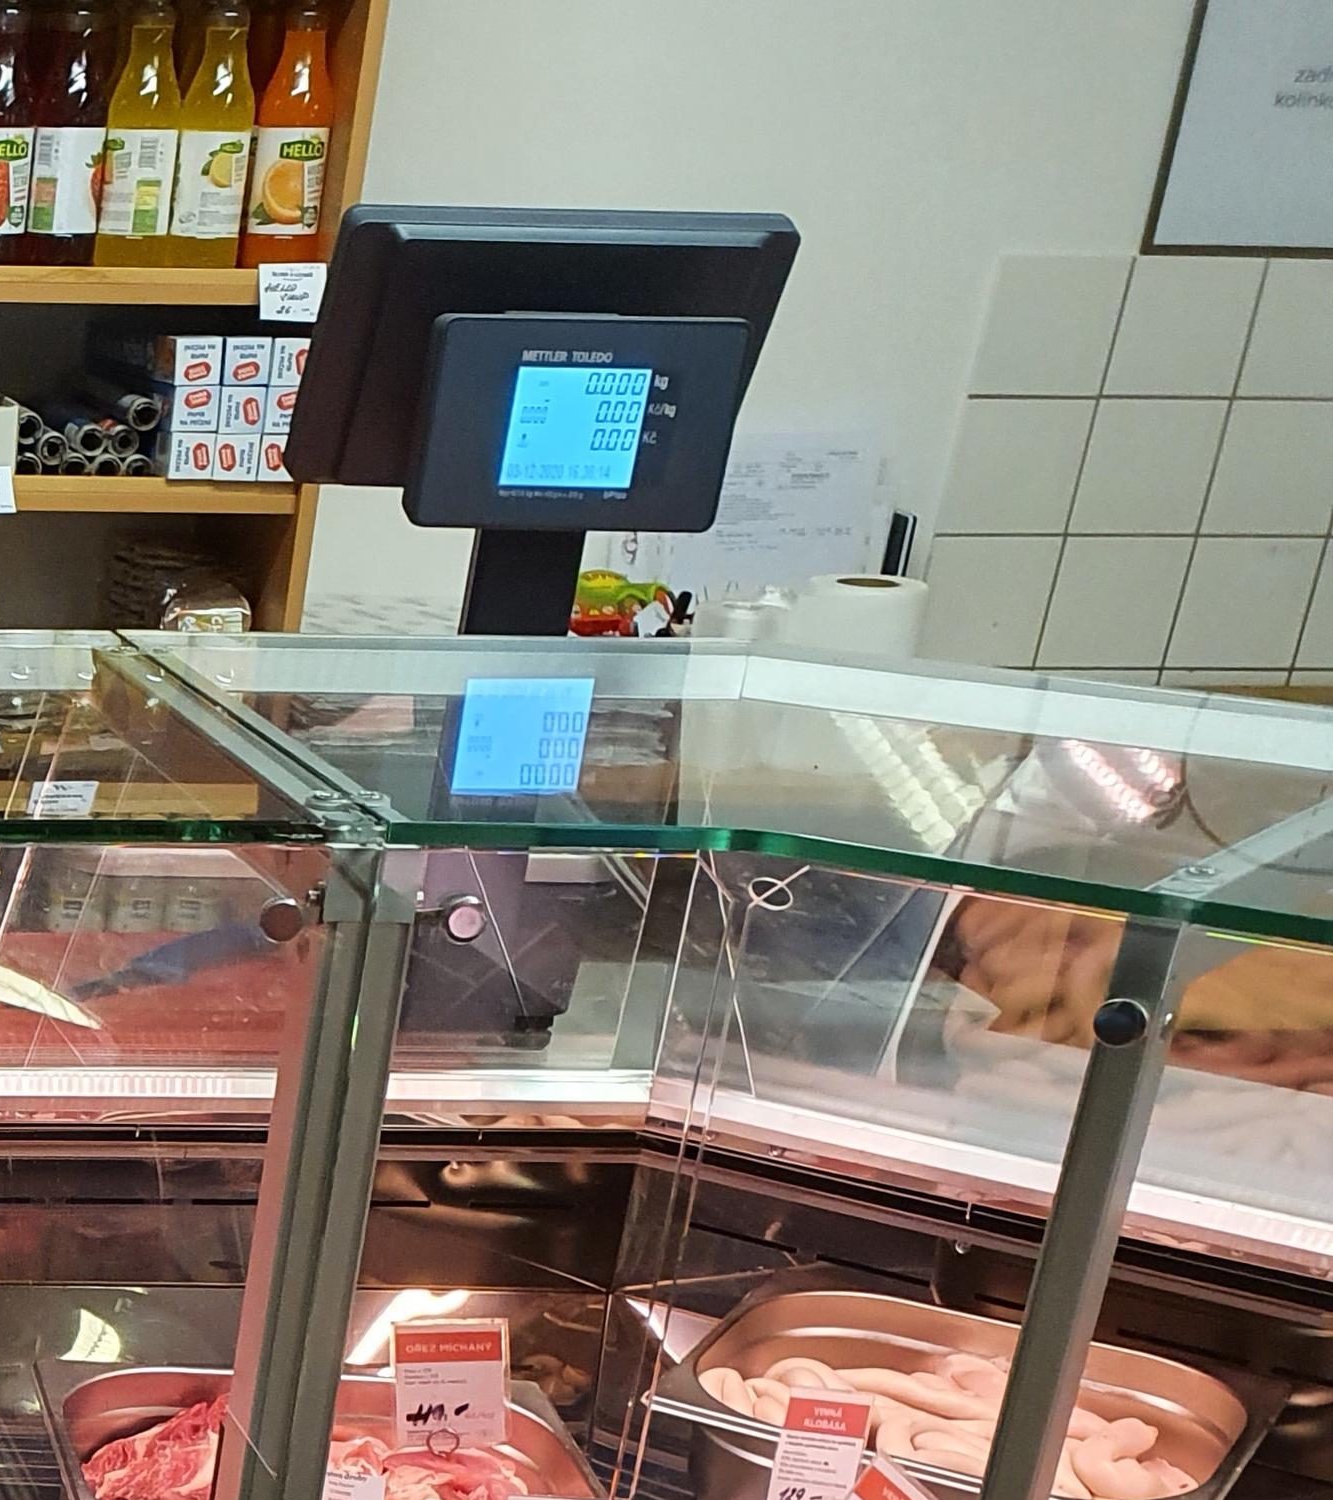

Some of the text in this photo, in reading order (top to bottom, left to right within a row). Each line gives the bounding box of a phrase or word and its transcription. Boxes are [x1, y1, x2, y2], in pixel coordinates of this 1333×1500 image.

[282, 143, 323, 158] HELLO
[522, 350, 614, 364] METTLER TOLEDO
[653, 374, 670, 391] kg
[642, 431, 658, 444] Kč
